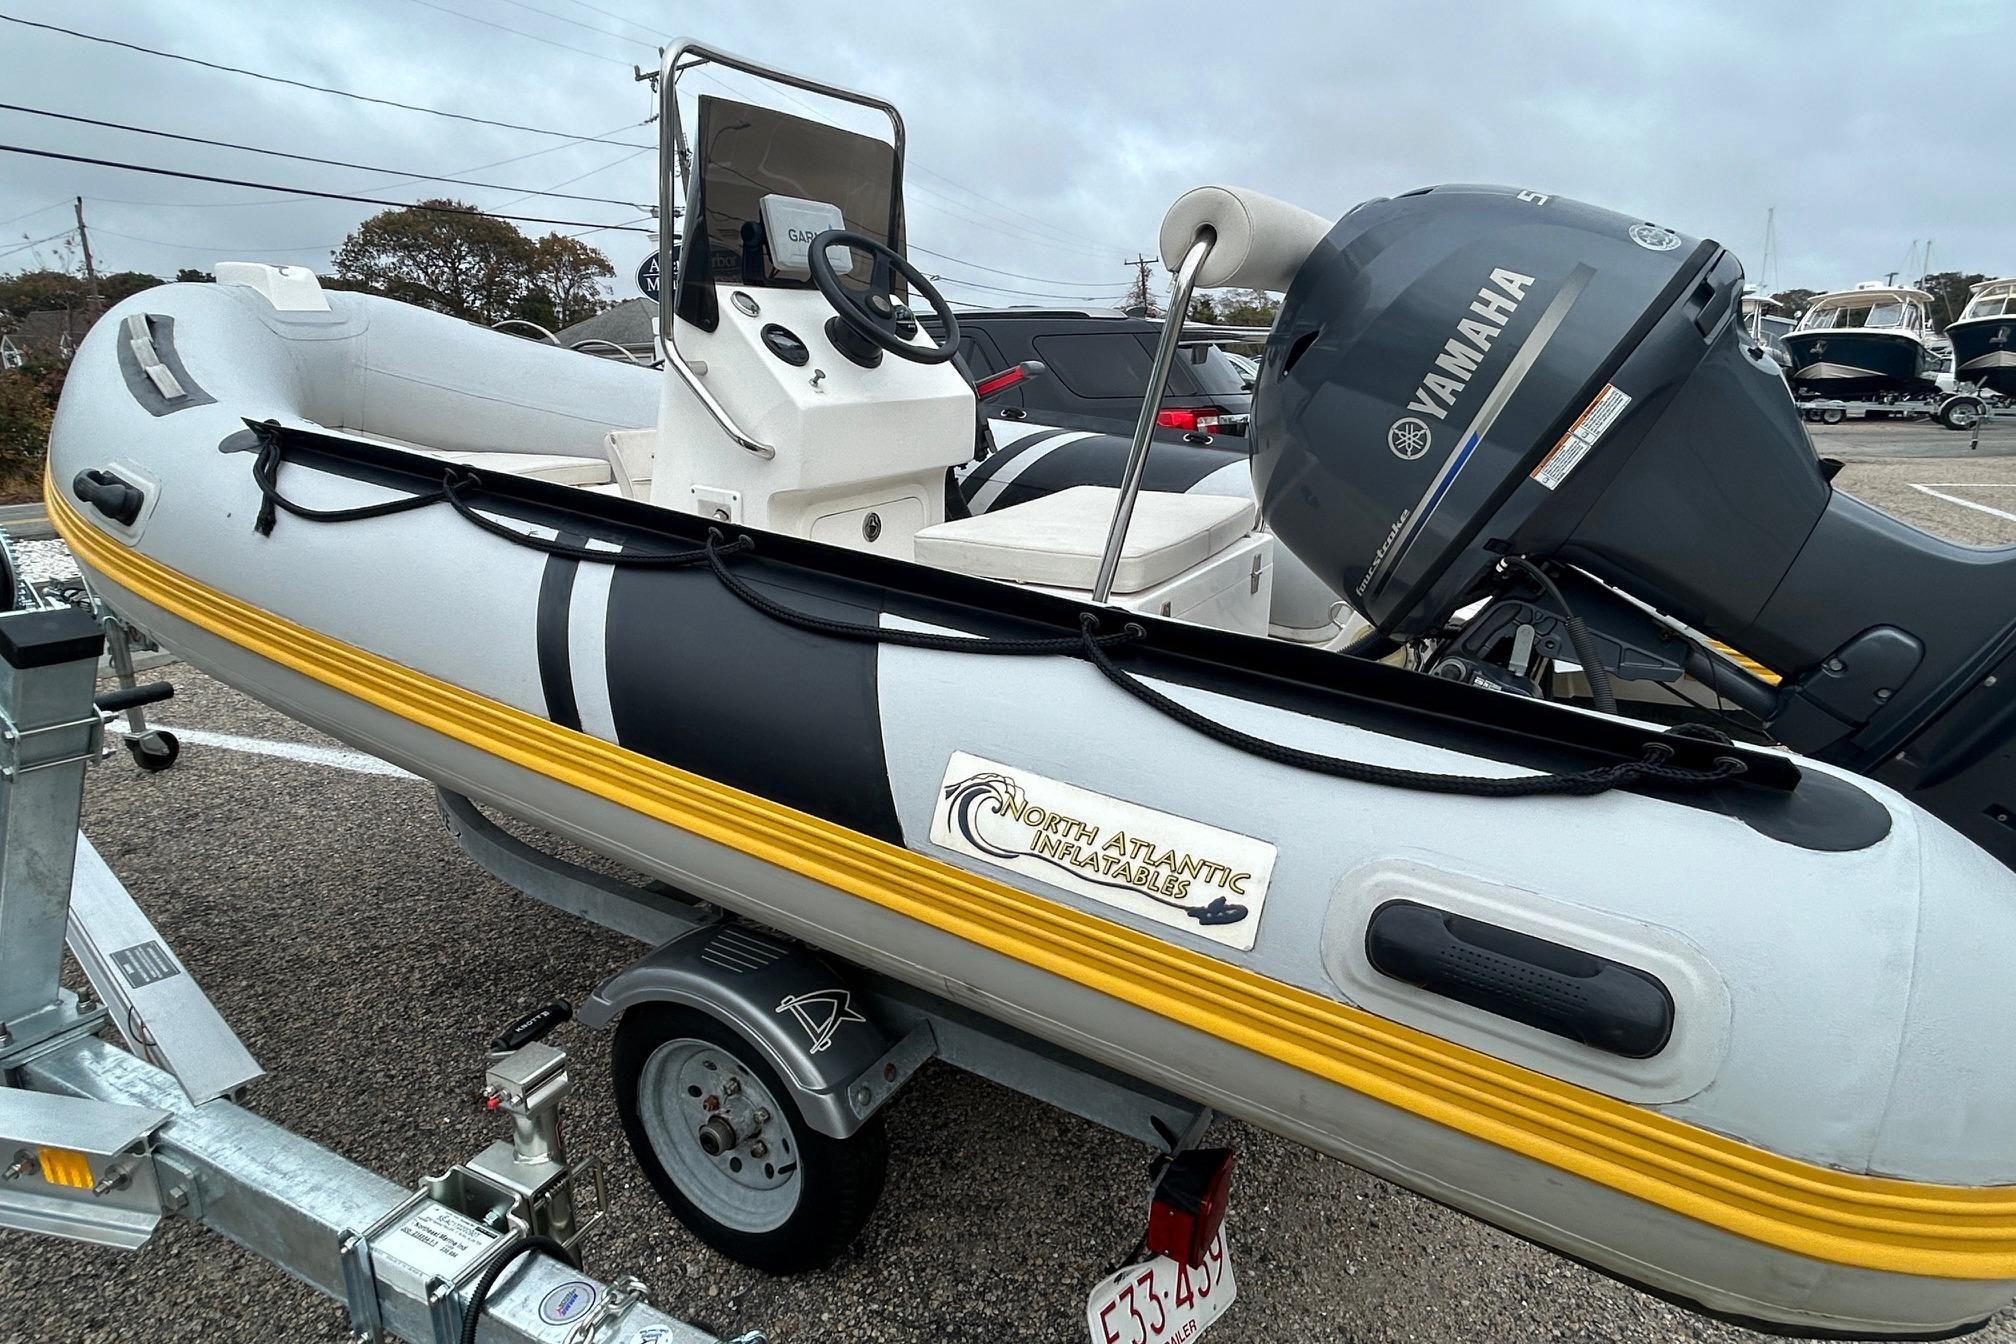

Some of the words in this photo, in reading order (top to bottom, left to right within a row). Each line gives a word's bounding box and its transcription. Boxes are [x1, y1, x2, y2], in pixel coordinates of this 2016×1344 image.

[788, 228, 819, 243] GAR
[1406, 267, 1536, 420] YAMAHA
[1029, 829, 1191, 900] INFLATABLES
